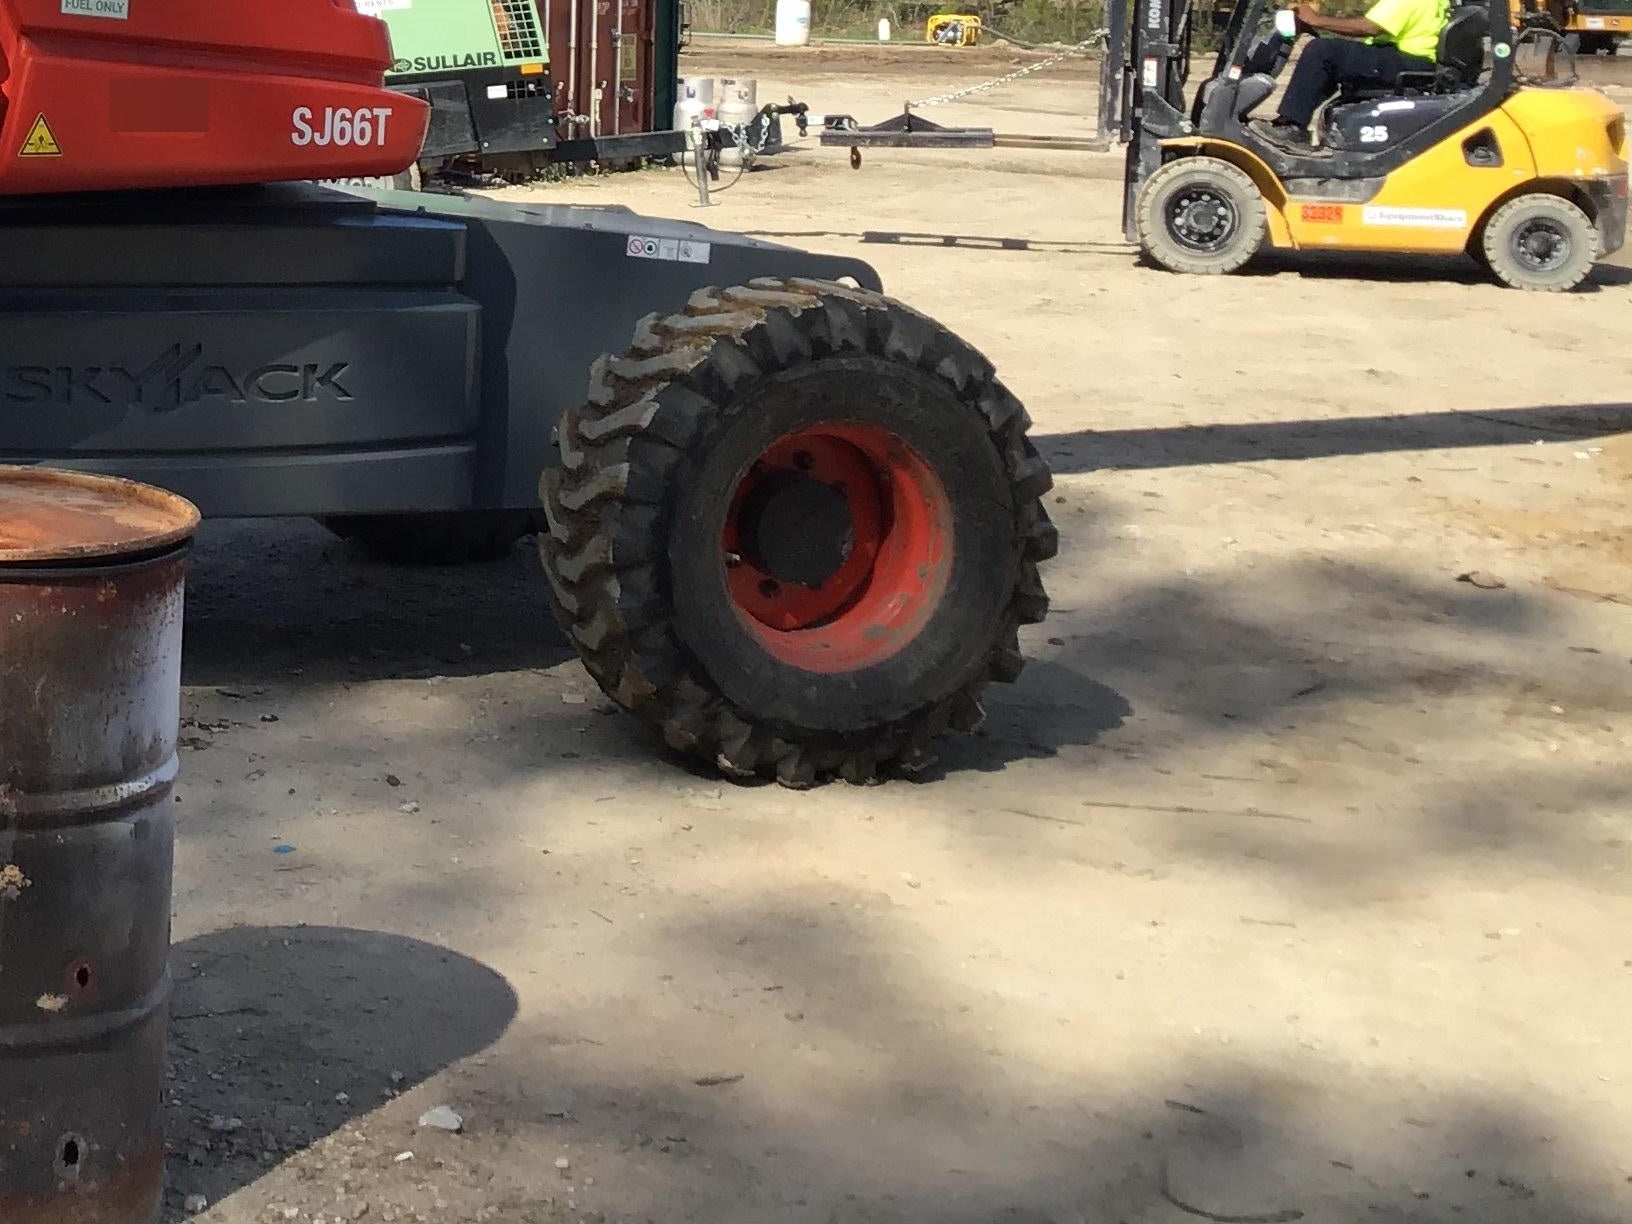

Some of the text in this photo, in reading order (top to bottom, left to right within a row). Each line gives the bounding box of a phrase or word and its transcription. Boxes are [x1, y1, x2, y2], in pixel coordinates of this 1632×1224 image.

[96, 0, 125, 14] ONLY
[414, 52, 496, 70] SULLAIR
[291, 106, 393, 146] SJ66T
[1360, 126, 1389, 143] 25
[6, 342, 354, 413] SKYJACK
